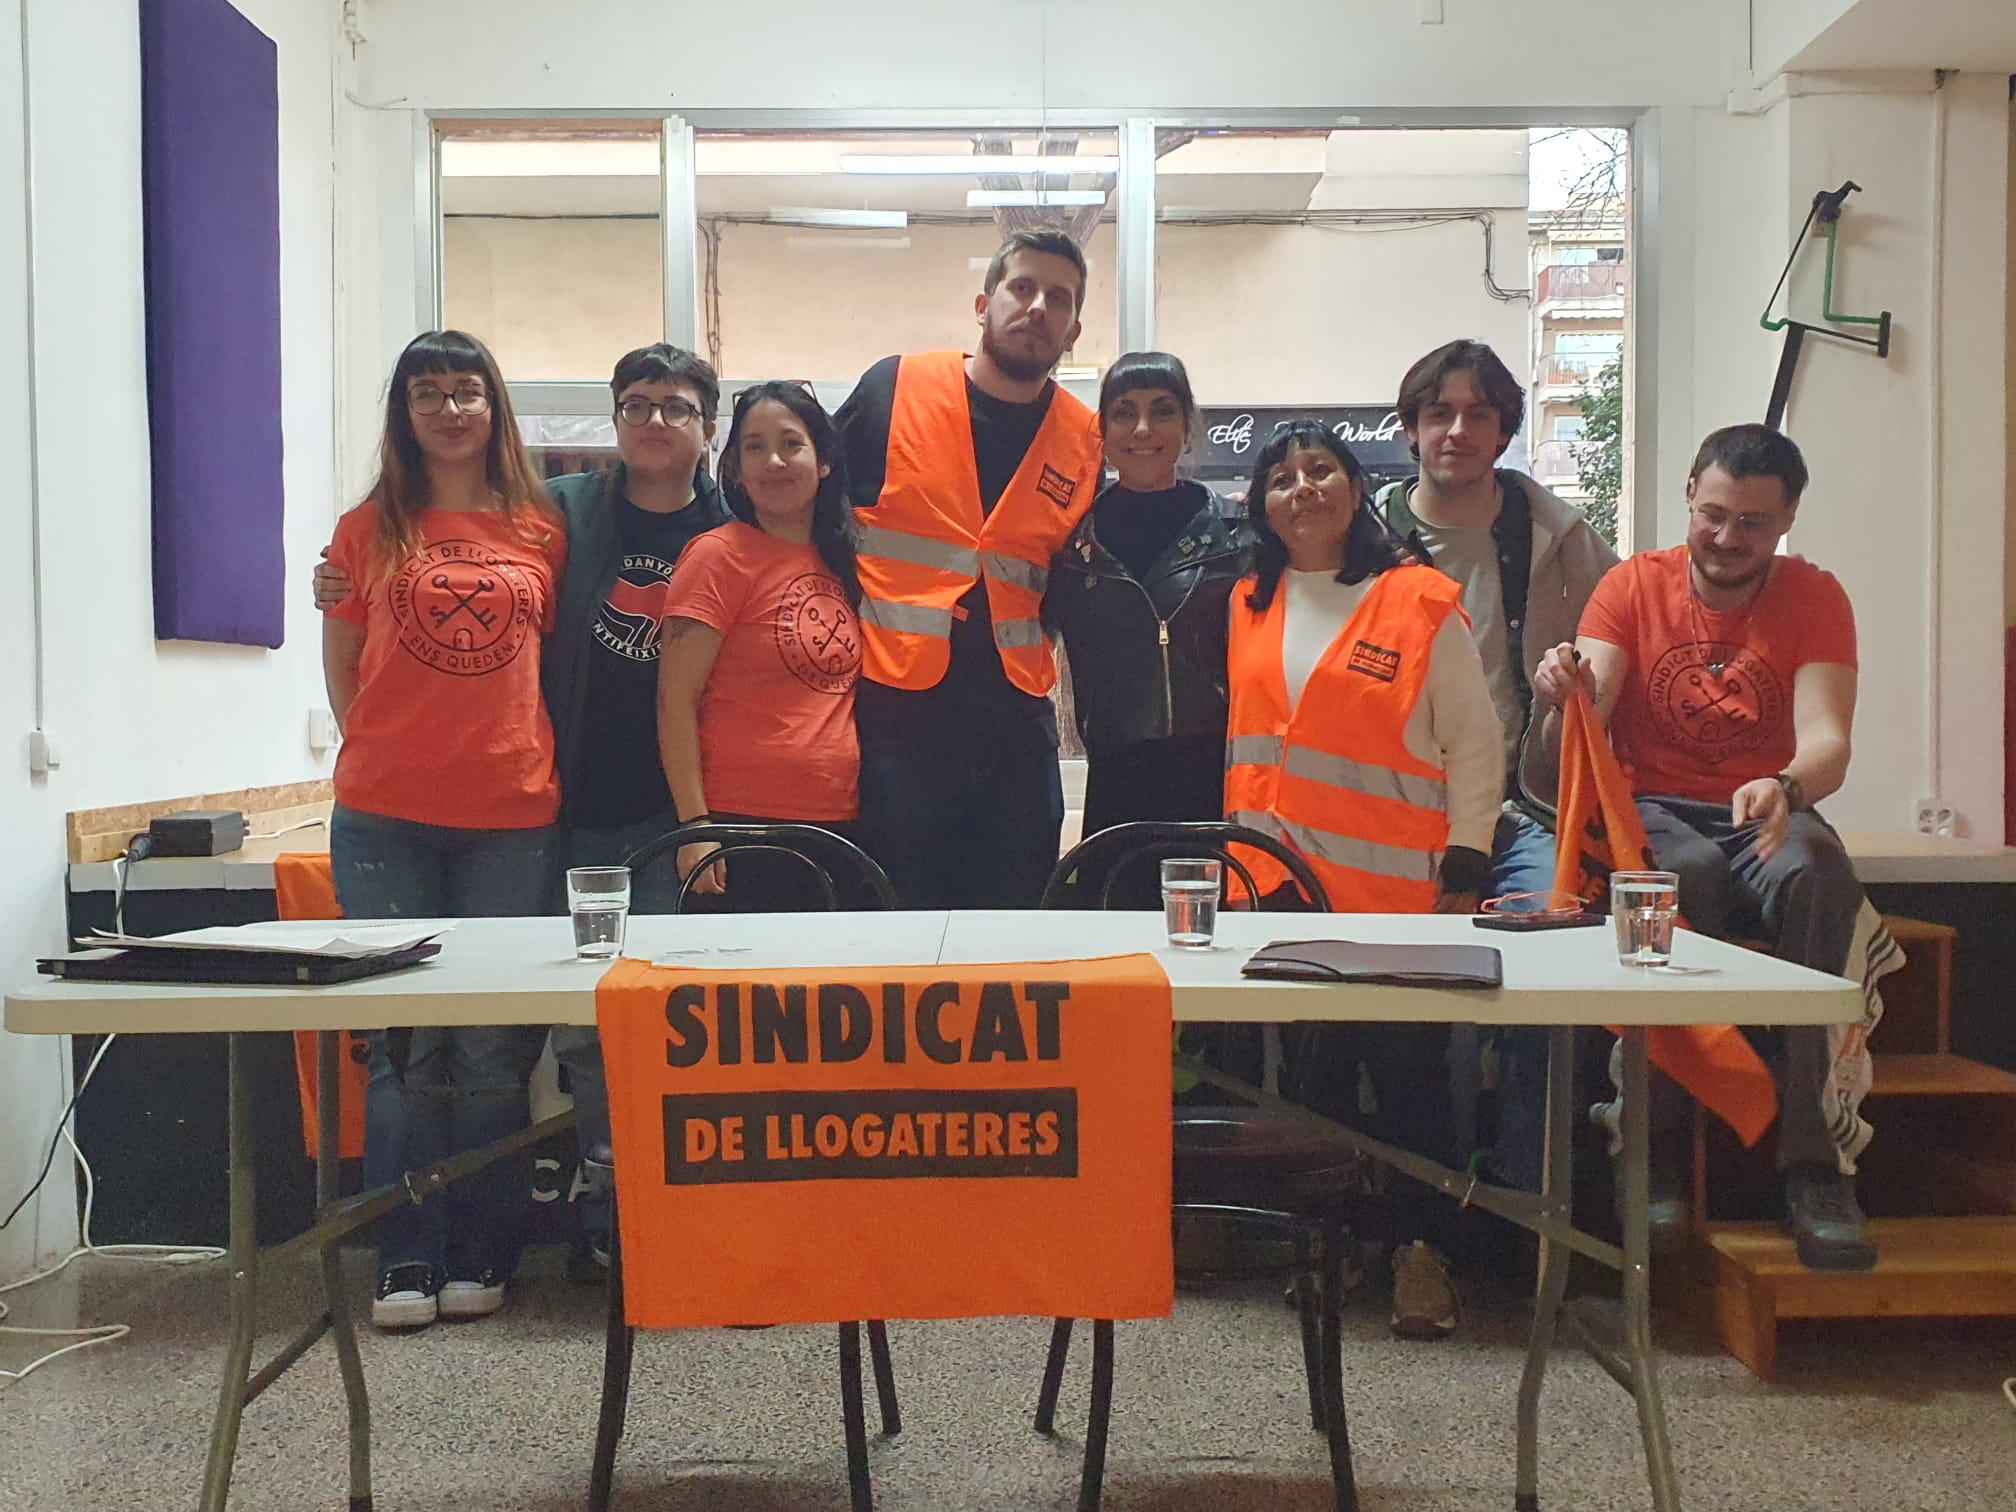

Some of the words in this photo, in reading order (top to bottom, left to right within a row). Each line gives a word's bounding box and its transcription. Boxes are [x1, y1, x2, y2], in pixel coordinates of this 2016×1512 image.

[1333, 412, 1404, 442] World
[441, 546, 462, 558] DE
[623, 558, 673, 577] DANYO
[410, 636, 441, 662] ENS
[446, 643, 516, 669] QUEDEM
[665, 981, 1071, 1068] SINDICAT
[684, 1115, 746, 1163] DE
[765, 1110, 1061, 1161] LLOGATERES
